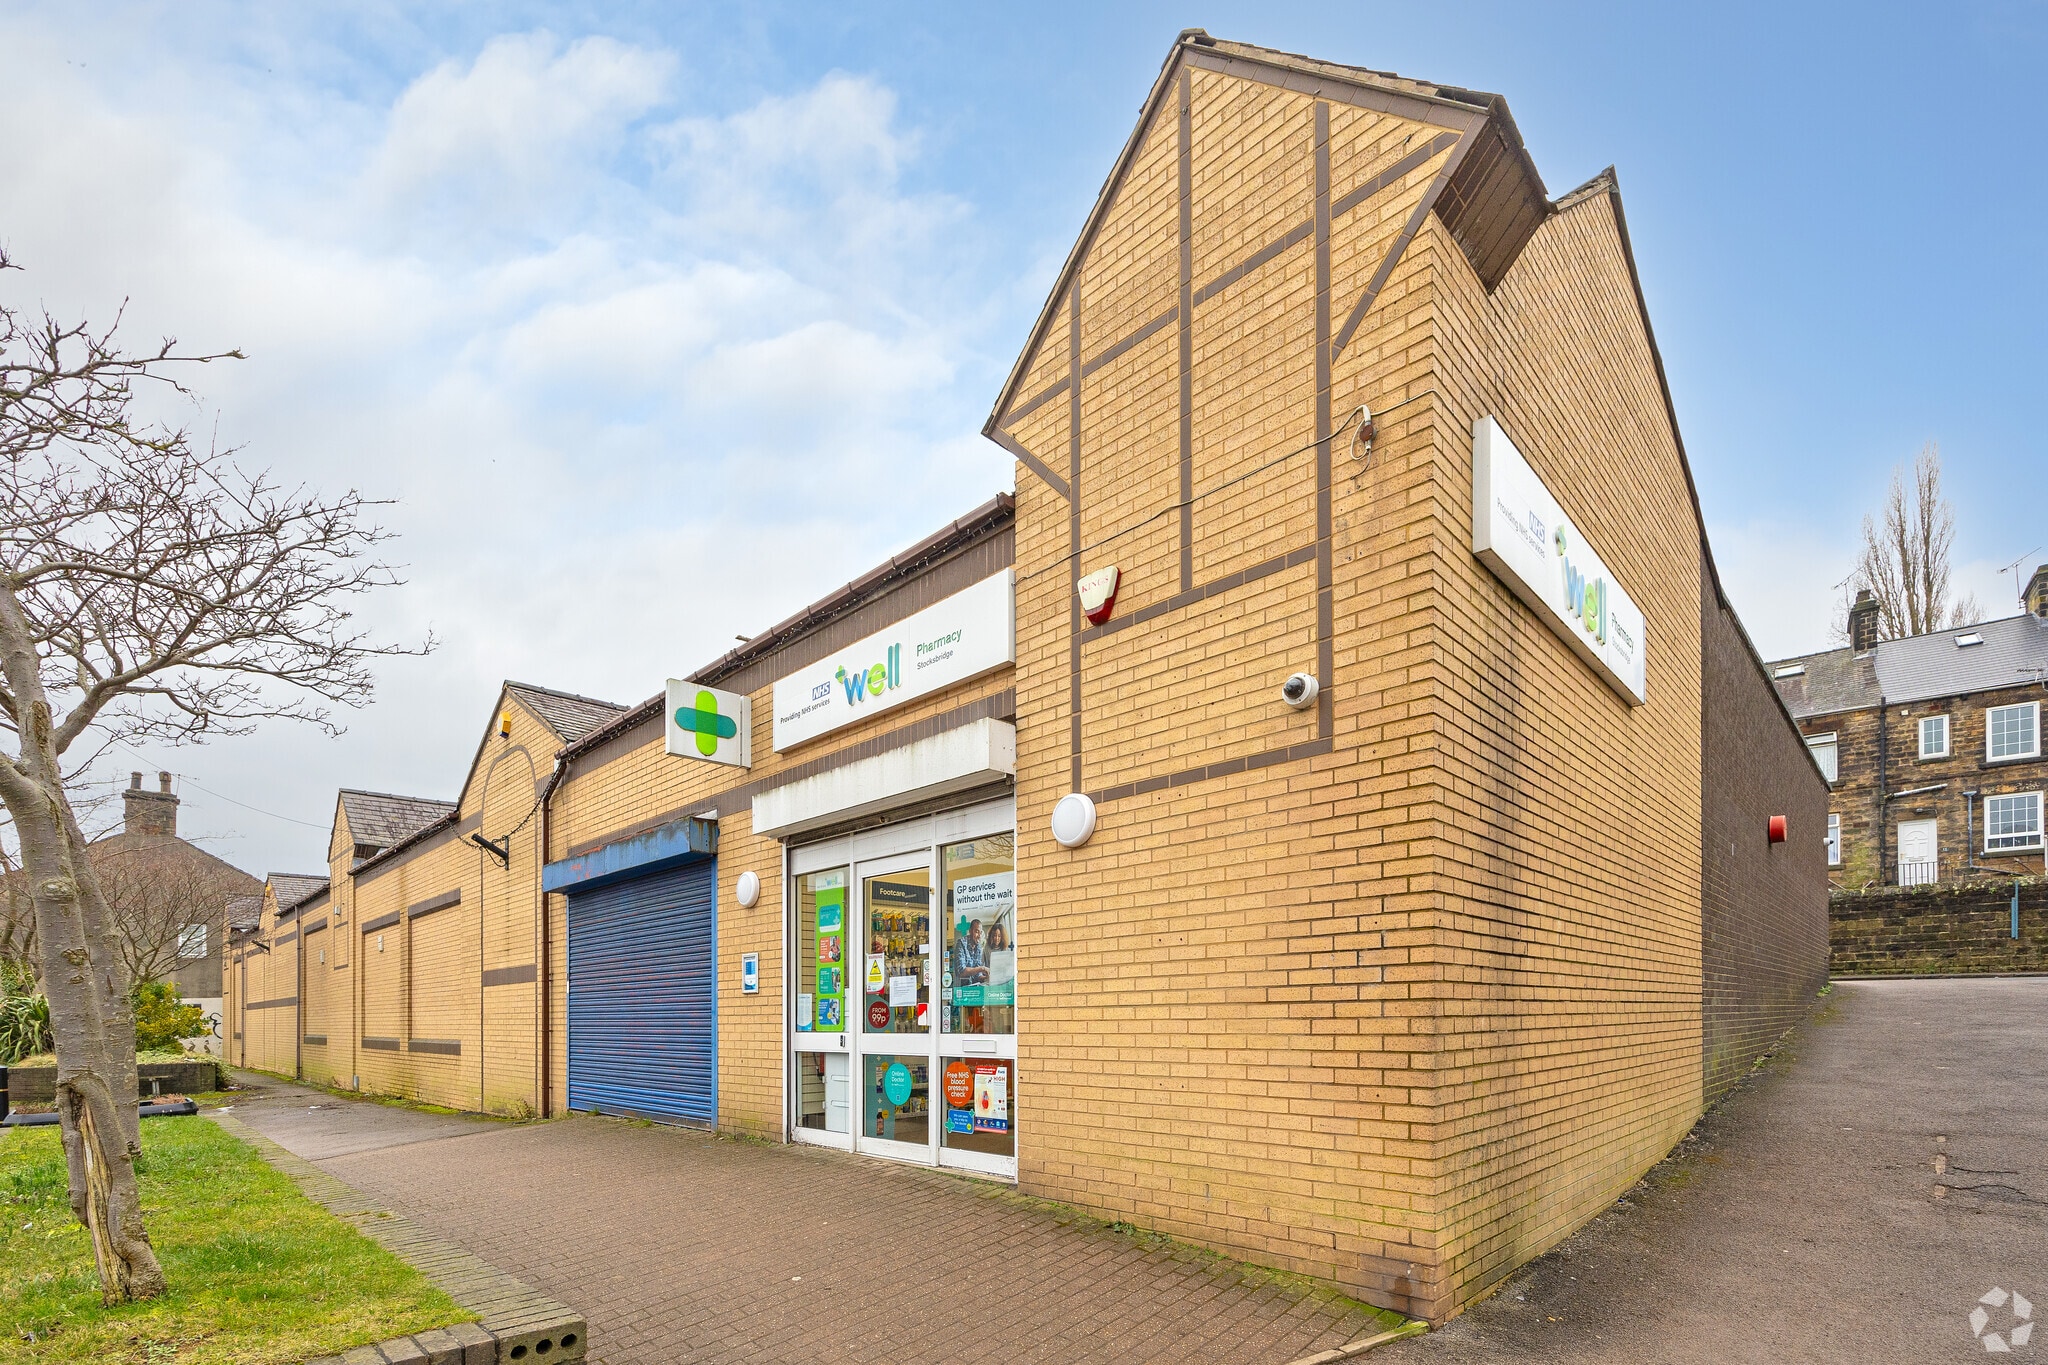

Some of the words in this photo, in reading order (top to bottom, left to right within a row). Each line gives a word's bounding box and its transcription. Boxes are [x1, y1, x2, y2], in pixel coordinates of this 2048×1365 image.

[1496, 496, 1519, 532] Providing
[1529, 535, 1545, 558] services
[1530, 511, 1545, 543] NHS
[1561, 556, 1607, 646] well
[916, 629, 962, 657] Pharmacy
[1611, 612, 1634, 654] Pharmacy
[916, 649, 954, 670] Stocksbridge
[844, 642, 901, 706] well
[812, 682, 830, 700] NHS
[780, 711, 801, 724] Providing
[801, 705, 811, 715] NHS
[811, 698, 830, 711] services
[880, 887, 906, 897] Footcare
[956, 885, 967, 894] GP
[968, 881, 996, 893] services
[957, 893, 983, 904] without
[983, 891, 996, 901] the
[996, 889, 1013, 899] wait
[871, 1013, 887, 1024] 99p
